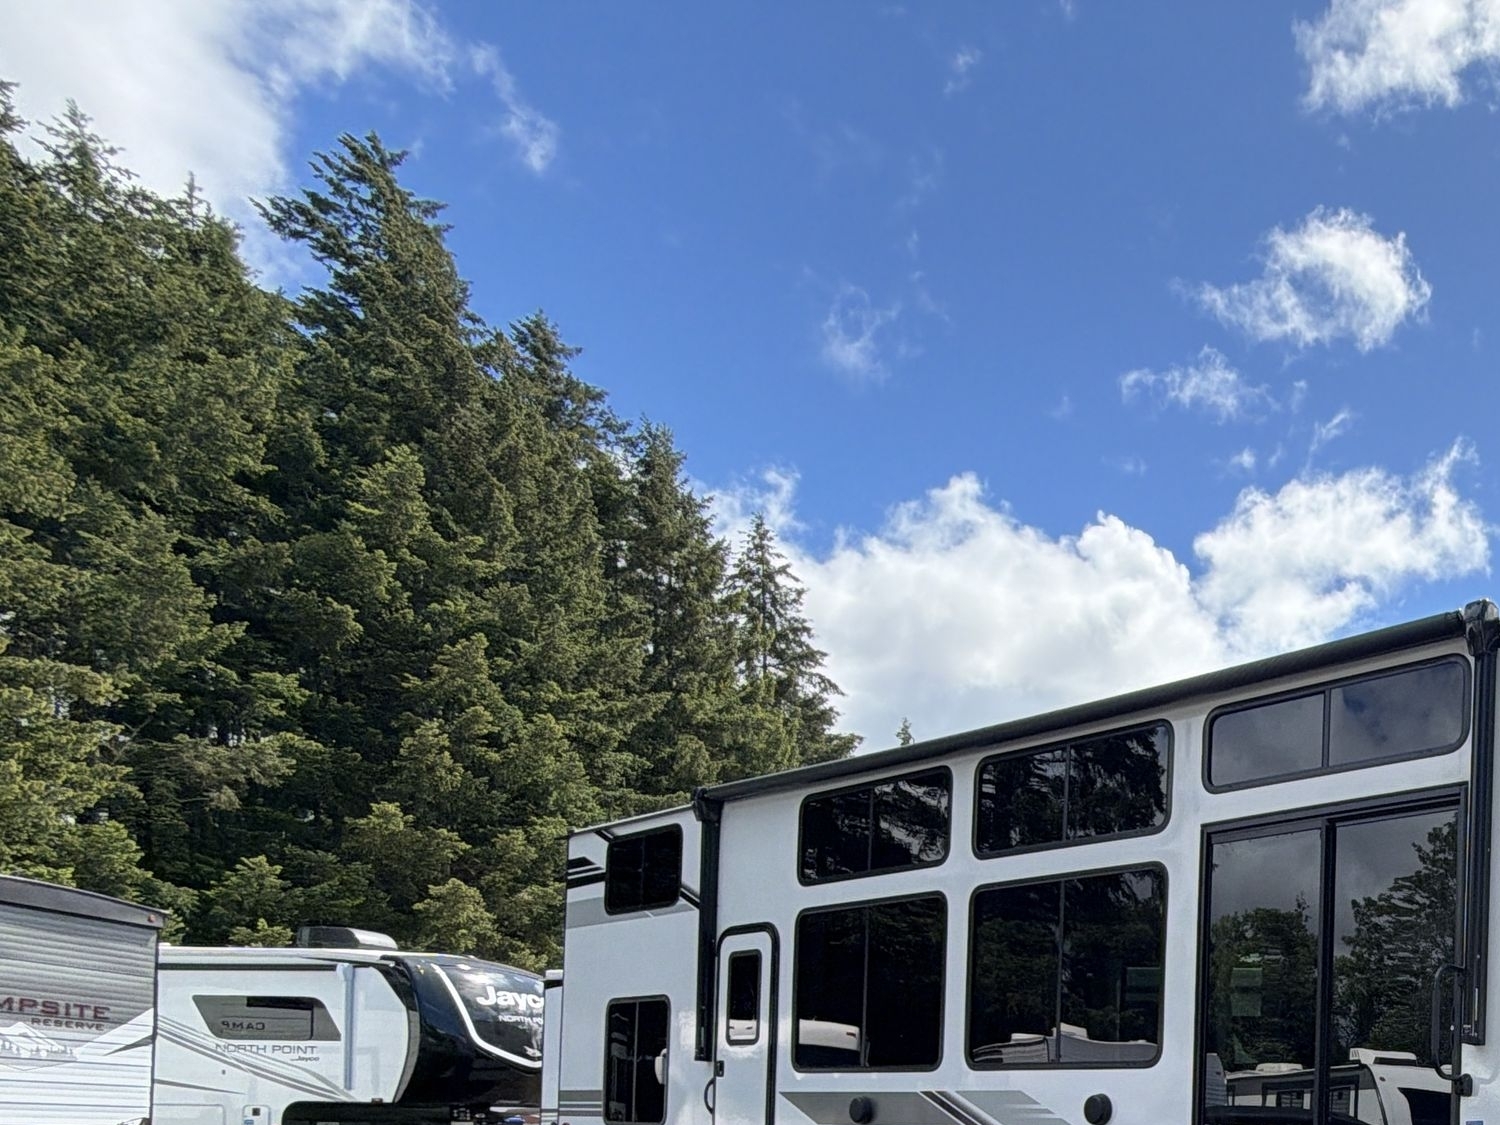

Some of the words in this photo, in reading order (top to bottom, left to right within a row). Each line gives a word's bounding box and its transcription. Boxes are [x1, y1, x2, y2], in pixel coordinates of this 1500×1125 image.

[31, 1018, 105, 1031] RESERVE
[215, 1043, 267, 1054] NORTH
[271, 1045, 318, 1055] POINT
